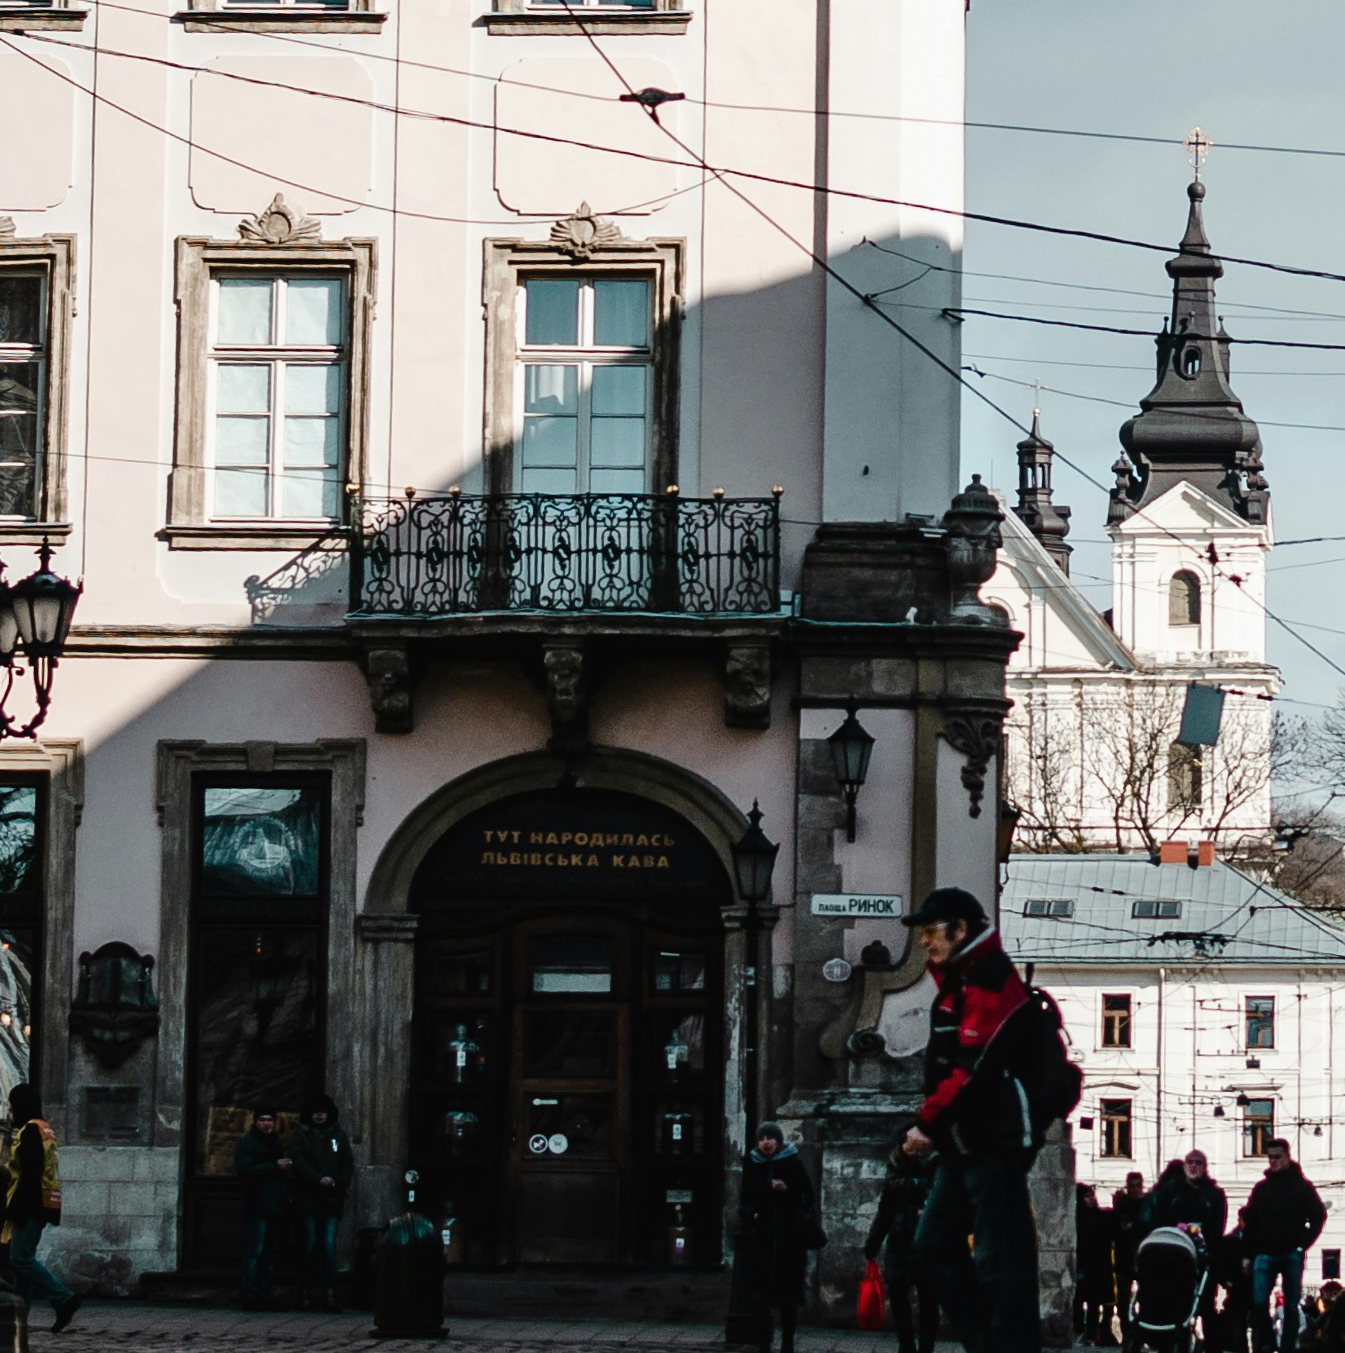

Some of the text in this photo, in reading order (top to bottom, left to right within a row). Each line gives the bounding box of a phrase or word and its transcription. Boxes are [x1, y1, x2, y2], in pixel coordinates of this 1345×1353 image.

[530, 832, 675, 847] НАРОДИЛАСЬ
[481, 852, 670, 868] ЛЬВІВСЬКА КАВА
[848, 899, 894, 913] РИНОК
